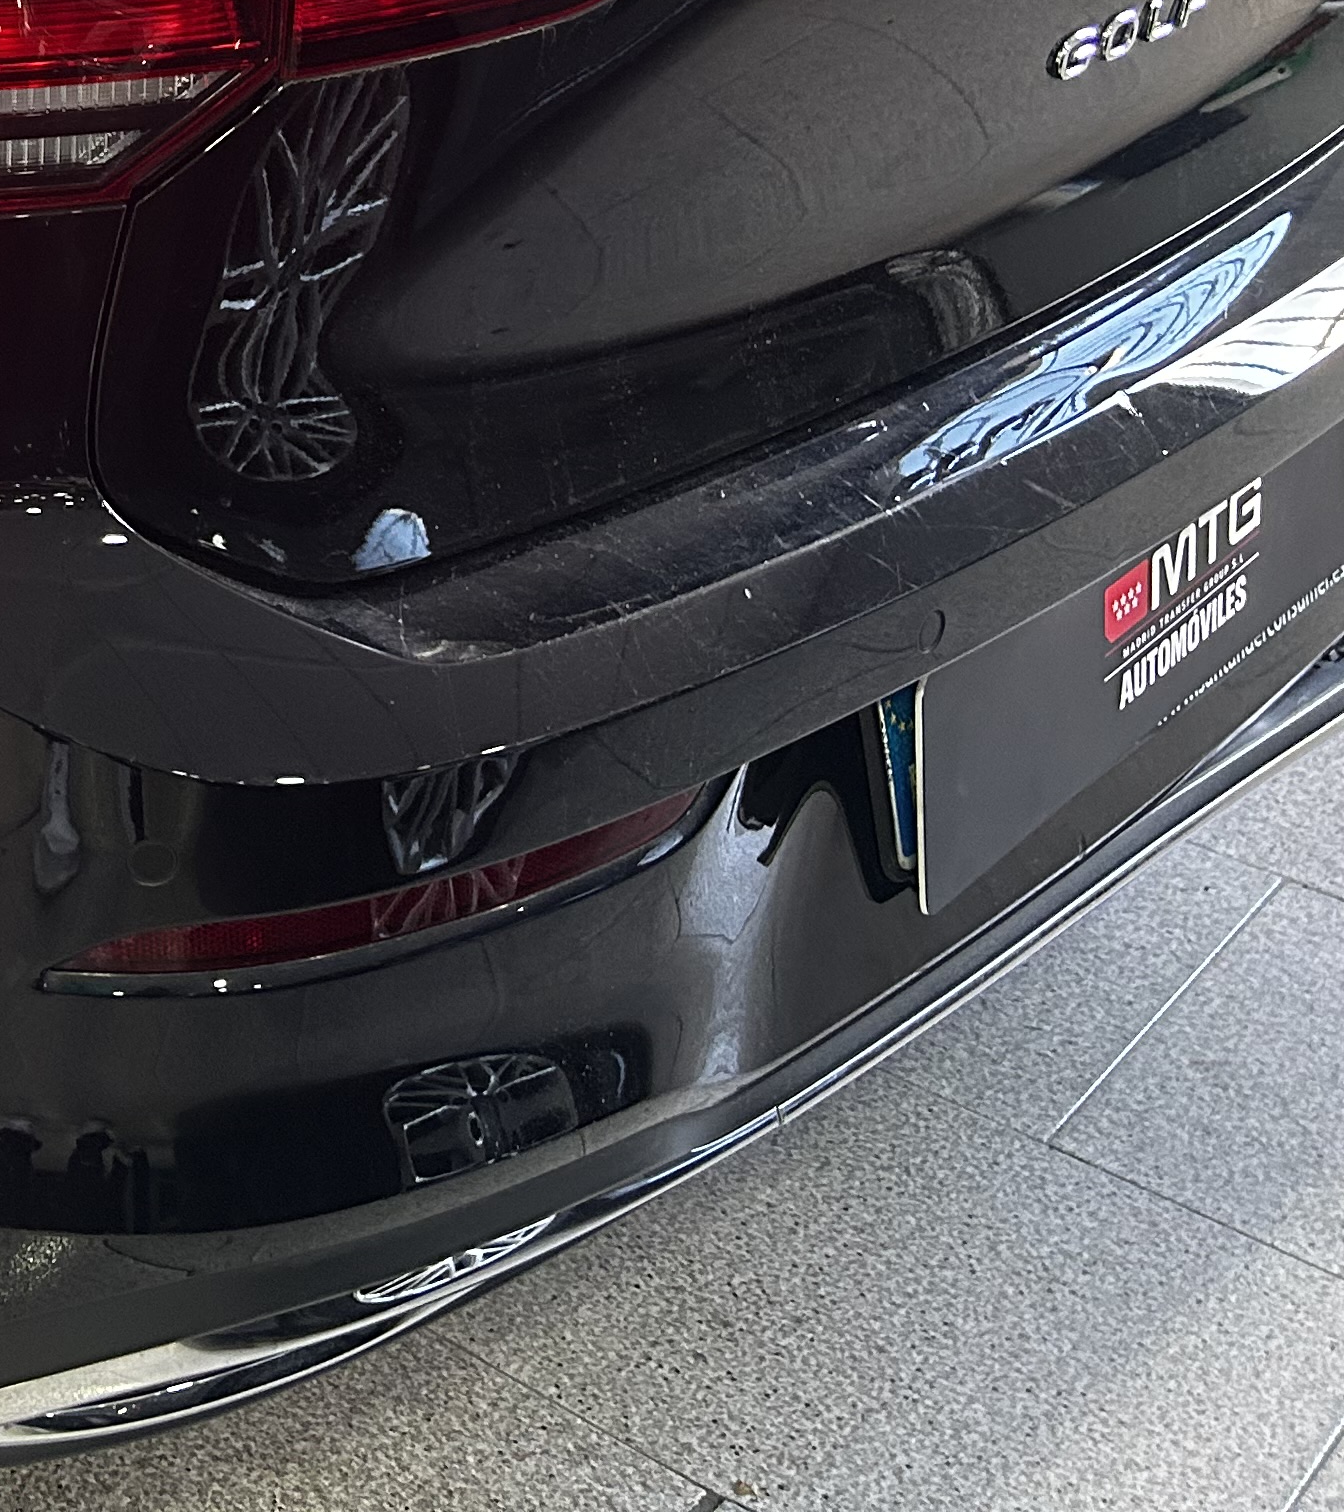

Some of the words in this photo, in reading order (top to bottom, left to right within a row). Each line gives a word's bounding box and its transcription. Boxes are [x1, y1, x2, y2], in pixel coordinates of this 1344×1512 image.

[1151, 476, 1262, 610] MTG
[1119, 574, 1247, 710] AUTOMÓVILES
[1122, 625, 1157, 659] MADRID
[1159, 586, 1201, 629] TRANSFER
[1203, 564, 1231, 593] GROUP
